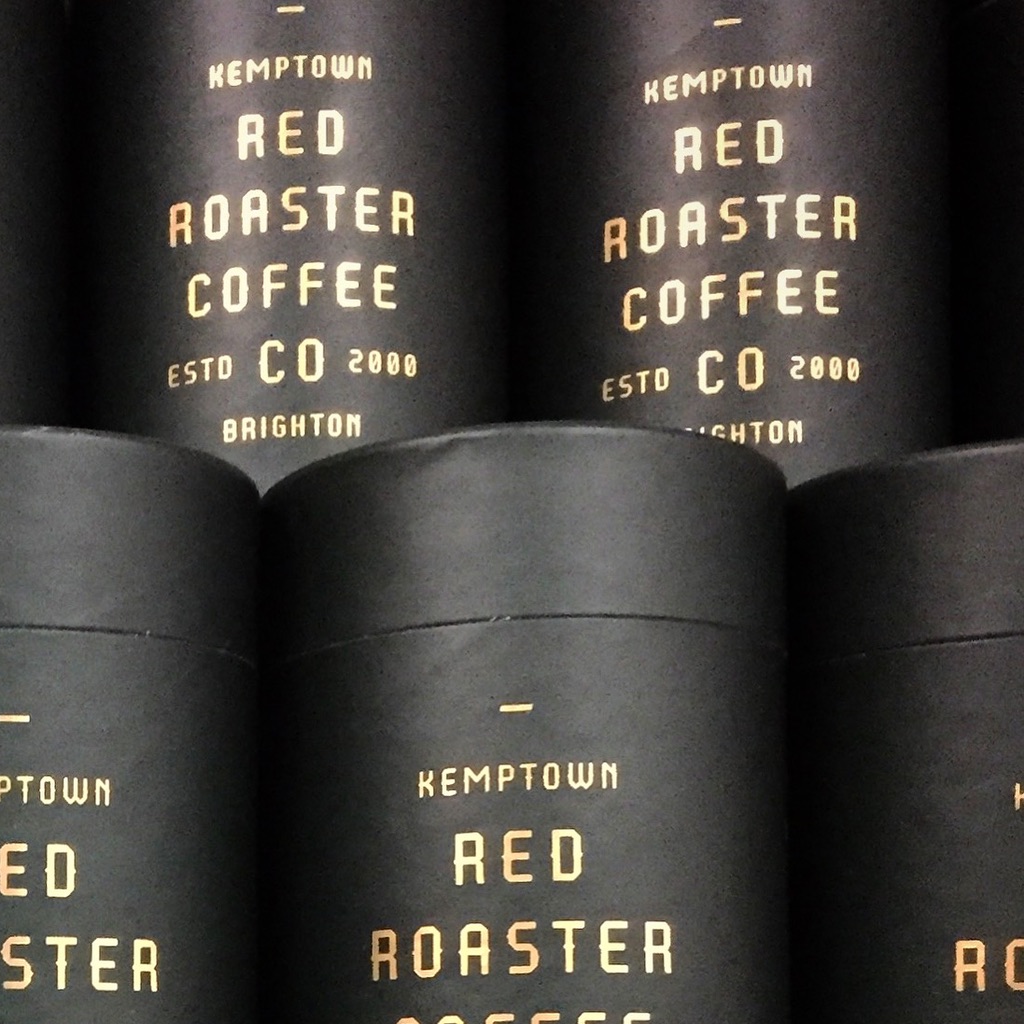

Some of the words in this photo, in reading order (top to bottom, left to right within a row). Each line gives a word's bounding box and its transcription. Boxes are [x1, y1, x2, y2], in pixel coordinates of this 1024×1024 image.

[209, 55, 372, 89] KEMPTOWN
[645, 64, 812, 104] KEMPTOWN
[237, 109, 347, 160] RED
[674, 119, 784, 174] RED
[168, 185, 414, 248] ROASTER
[604, 194, 856, 263] ROASTER
[188, 261, 397, 318] COFFEE
[622, 269, 839, 331] COFFEE
[168, 355, 233, 390] ESTD
[259, 338, 324, 383] CO
[349, 349, 417, 377] 2000
[601, 367, 669, 402] ESTD
[697, 347, 764, 394] CO
[790, 356, 859, 381] 2000
[223, 413, 361, 443] BRIGHTON
[685, 420, 802, 444] GHTON
[418, 762, 617, 798] KEMPTOWN
[454, 829, 583, 885] RED
[371, 921, 672, 981] ROASTER
